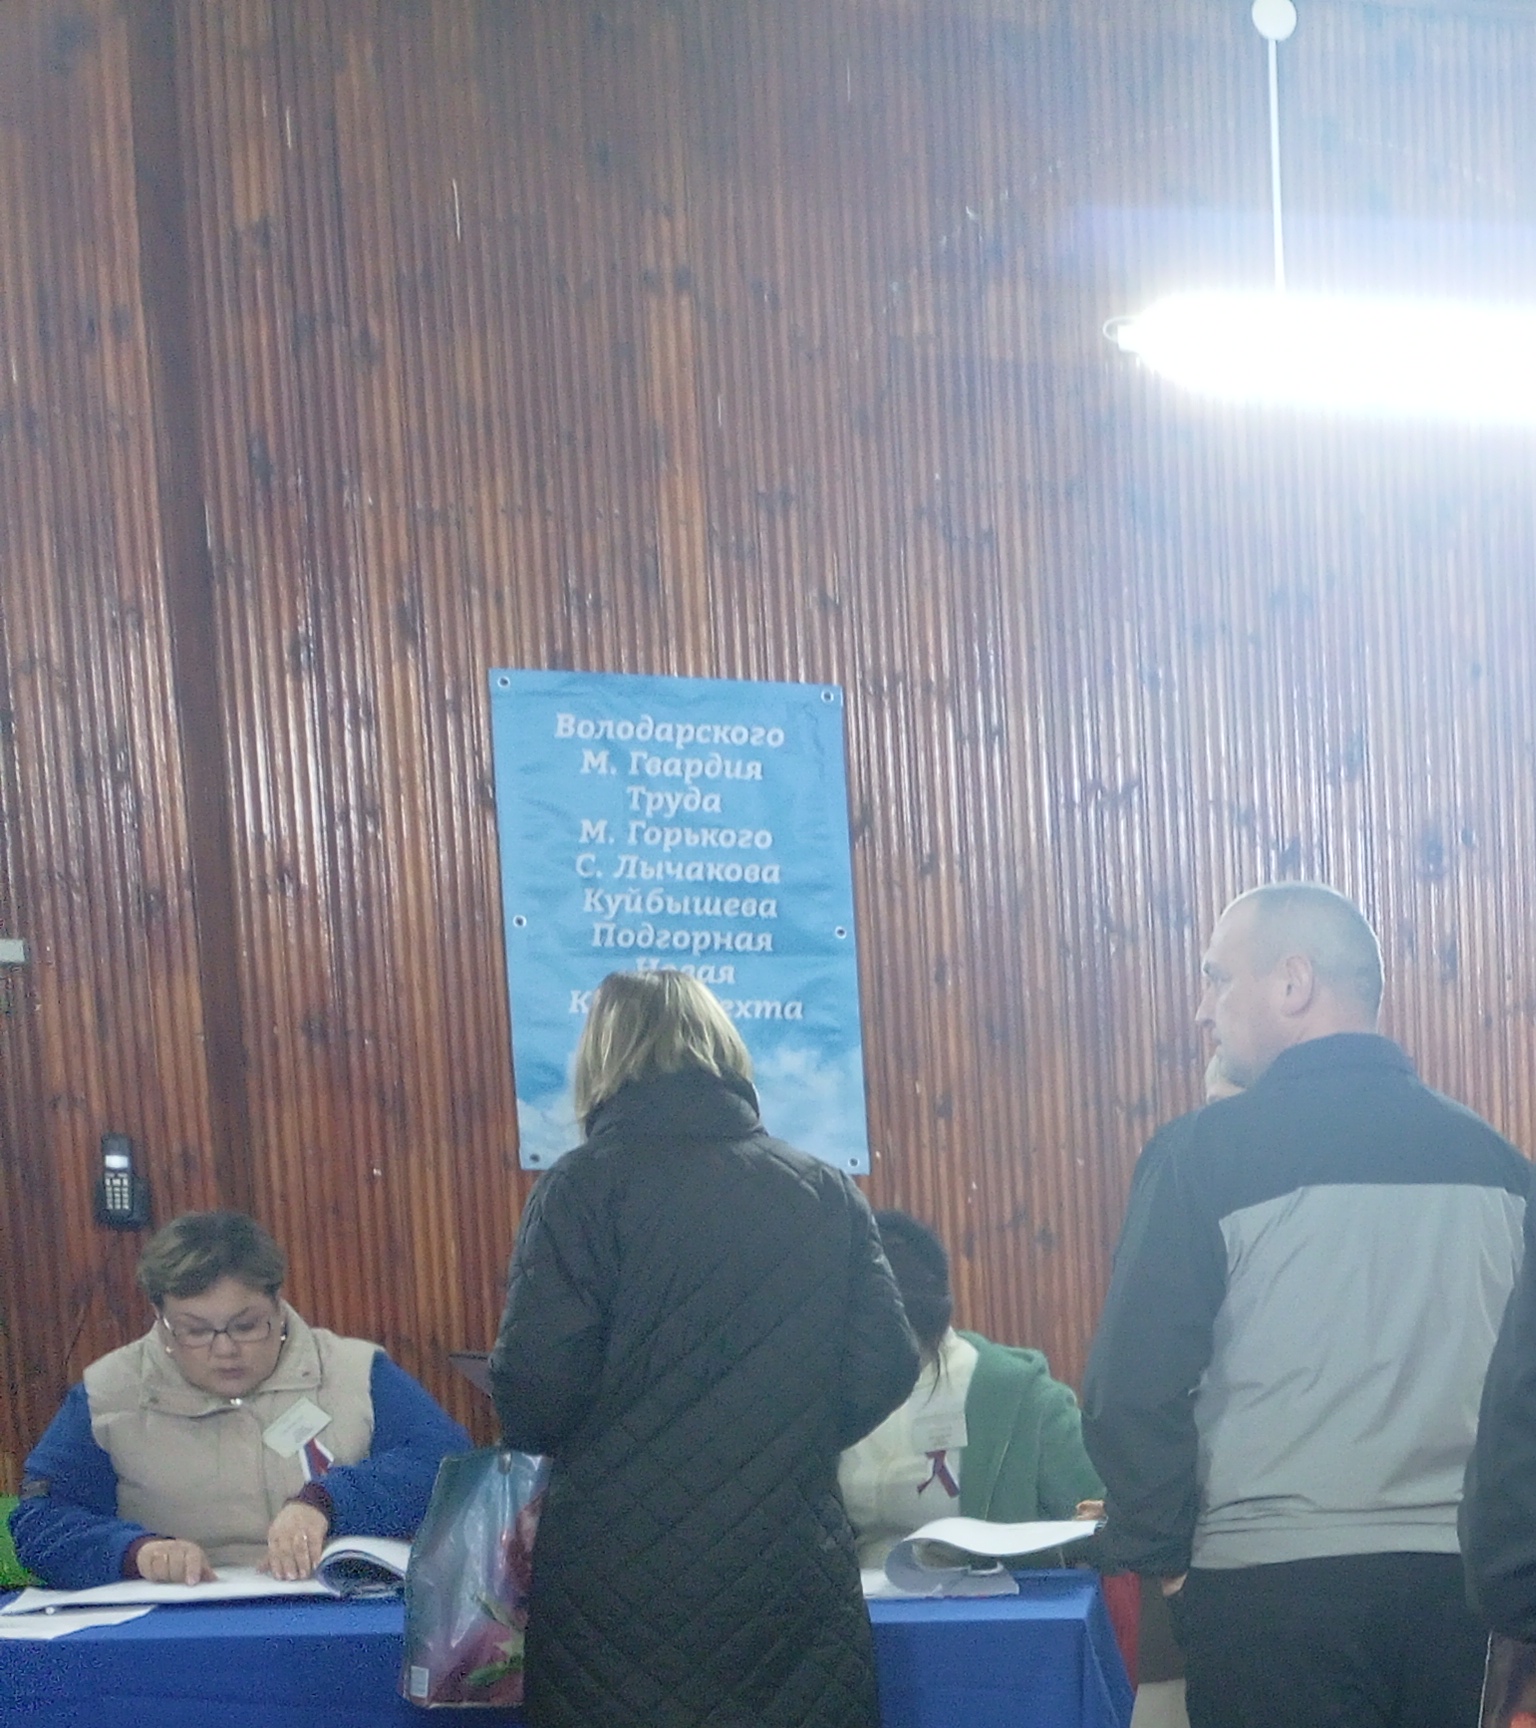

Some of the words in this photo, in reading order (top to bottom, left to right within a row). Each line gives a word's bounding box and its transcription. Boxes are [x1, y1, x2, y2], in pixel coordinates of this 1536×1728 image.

[554, 712, 785, 749] Володарского
[580, 748, 617, 776] М.
[628, 751, 763, 784] Гвардия
[626, 785, 722, 818] Труда
[578, 818, 615, 845] М.
[627, 820, 773, 852] Горького
[575, 852, 603, 877] С.
[613, 854, 780, 884] Лычакова
[583, 887, 778, 919] Куйбышева
[591, 922, 774, 954] Подгорная
